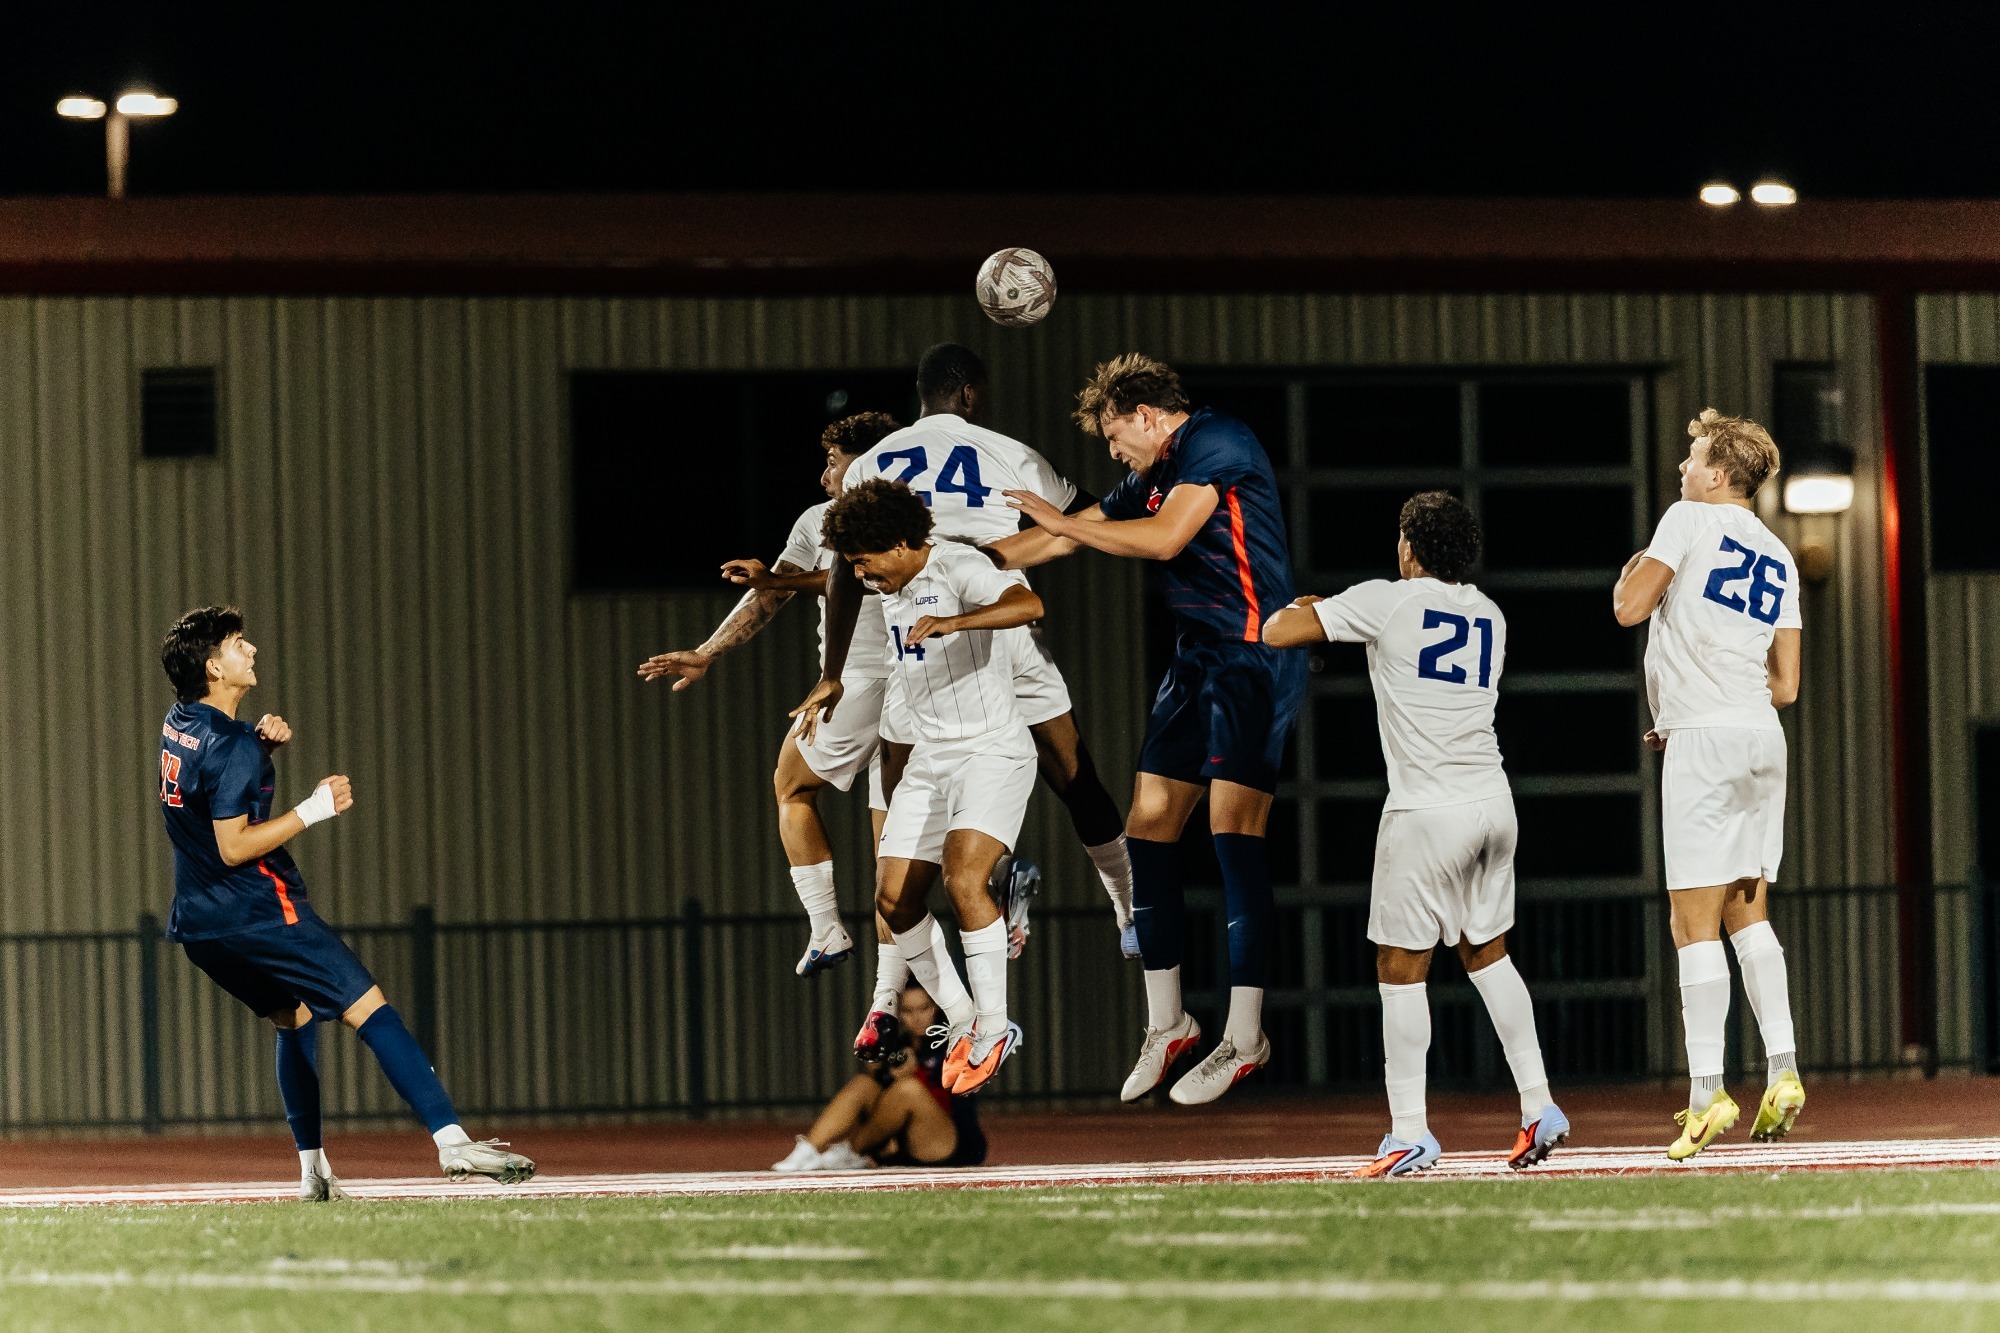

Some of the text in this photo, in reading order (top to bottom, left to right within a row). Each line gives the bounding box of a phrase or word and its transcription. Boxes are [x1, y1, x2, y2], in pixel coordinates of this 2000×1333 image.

[877, 446, 993, 507] 24
[915, 595, 938, 606] LOPES
[1702, 534, 1787, 627] 26
[891, 625, 926, 661] 14
[1418, 608, 1493, 689] 21
[178, 732, 200, 751] TECH
